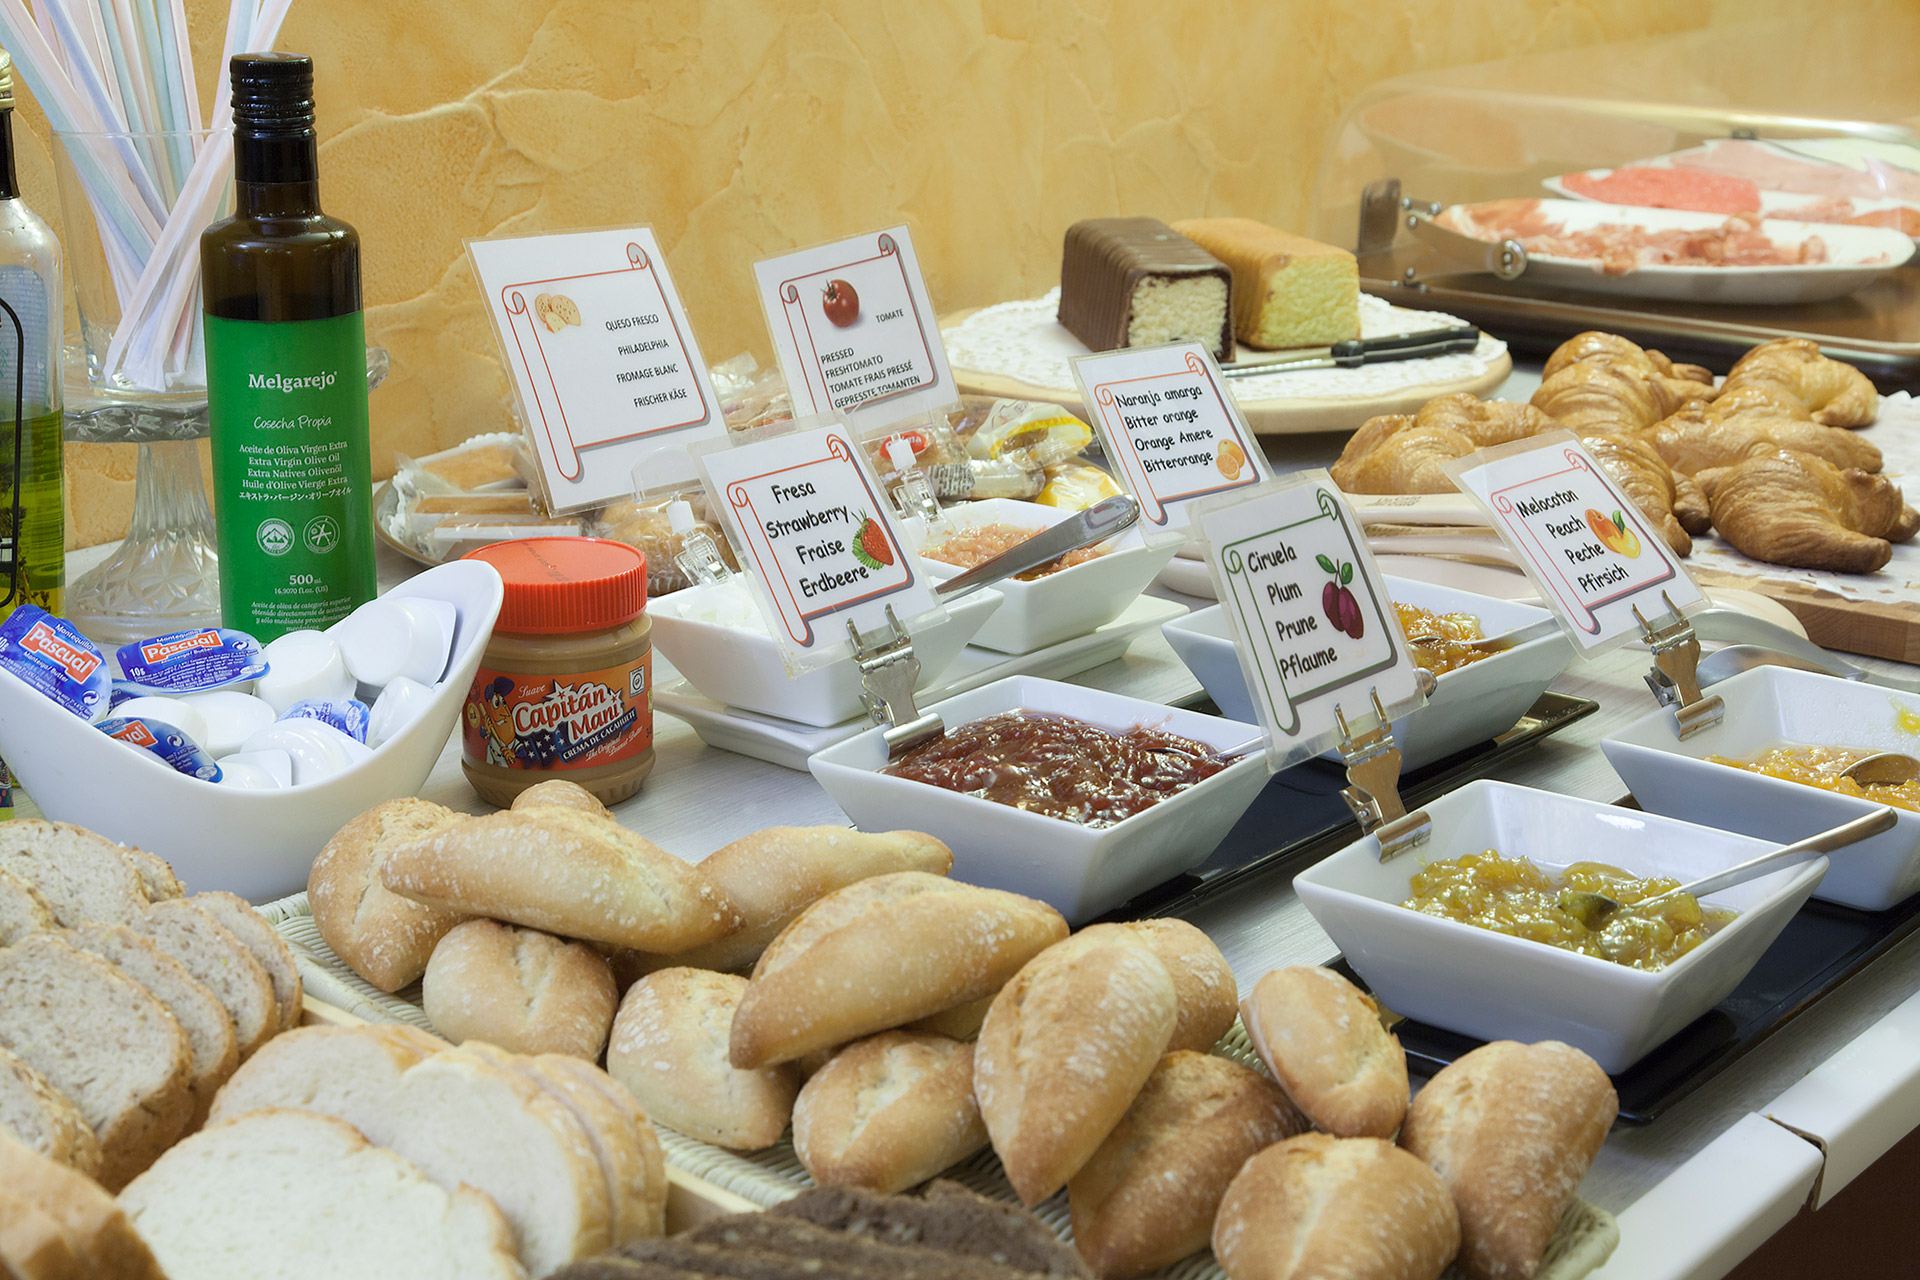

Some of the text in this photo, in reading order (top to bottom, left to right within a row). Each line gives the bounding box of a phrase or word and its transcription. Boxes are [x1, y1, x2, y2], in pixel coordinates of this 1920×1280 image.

[605, 313, 660, 332] QUESO FRESCO
[876, 308, 904, 324] TOMATE
[617, 339, 669, 356] PHILADELPHIA
[821, 347, 855, 365] PRESSED
[616, 363, 679, 384] FROMAGE BLANC
[825, 354, 884, 379] FRESHTOMATO
[829, 359, 914, 394] TOMATE FRAIS PRESSÉ
[248, 371, 336, 393] Melgarejo
[834, 374, 921, 409] GEPRESSTE TOMANTEN
[633, 388, 688, 408] FRISCHER KÄSE
[1115, 385, 1203, 408] Naranja amarga
[253, 415, 332, 431] Cosecha Propia
[1125, 408, 1199, 430] Bitter orange
[239, 441, 348, 455] Aceite de Oliva Virgen Extra
[1134, 428, 1214, 451] Orange Amere
[247, 464, 342, 478] Extra Natives Olivenöl
[248, 452, 340, 468] Extra Virgin Olive Oil
[1142, 451, 1214, 473] Bitterorange
[242, 476, 348, 490] Huile d'Olive Vierge Extra
[770, 481, 817, 504] Fresa
[1515, 487, 1580, 518] Melocoton
[765, 505, 850, 539] Strawberry
[1545, 515, 1587, 539] Peach
[795, 539, 846, 565] Fraise
[1247, 541, 1298, 573] Ciruela
[1564, 541, 1605, 565] Peche
[289, 574, 314, 585] 500
[799, 565, 870, 598] Erdbeere
[1577, 563, 1630, 593] Pfirsich
[1266, 582, 1303, 605] Plum
[55, 623, 94, 650] Mantequilla
[156, 630, 200, 643] Mantequilla
[1275, 615, 1318, 642] Prune
[29, 628, 93, 673] Pascual
[146, 634, 214, 659] Pascual
[129, 667, 146, 677] 10g
[1279, 646, 1339, 680] Pflaume
[518, 684, 546, 699] Suave
[515, 686, 607, 732] Capitán
[562, 742, 589, 760] CREMA
[589, 734, 600, 747] DE
